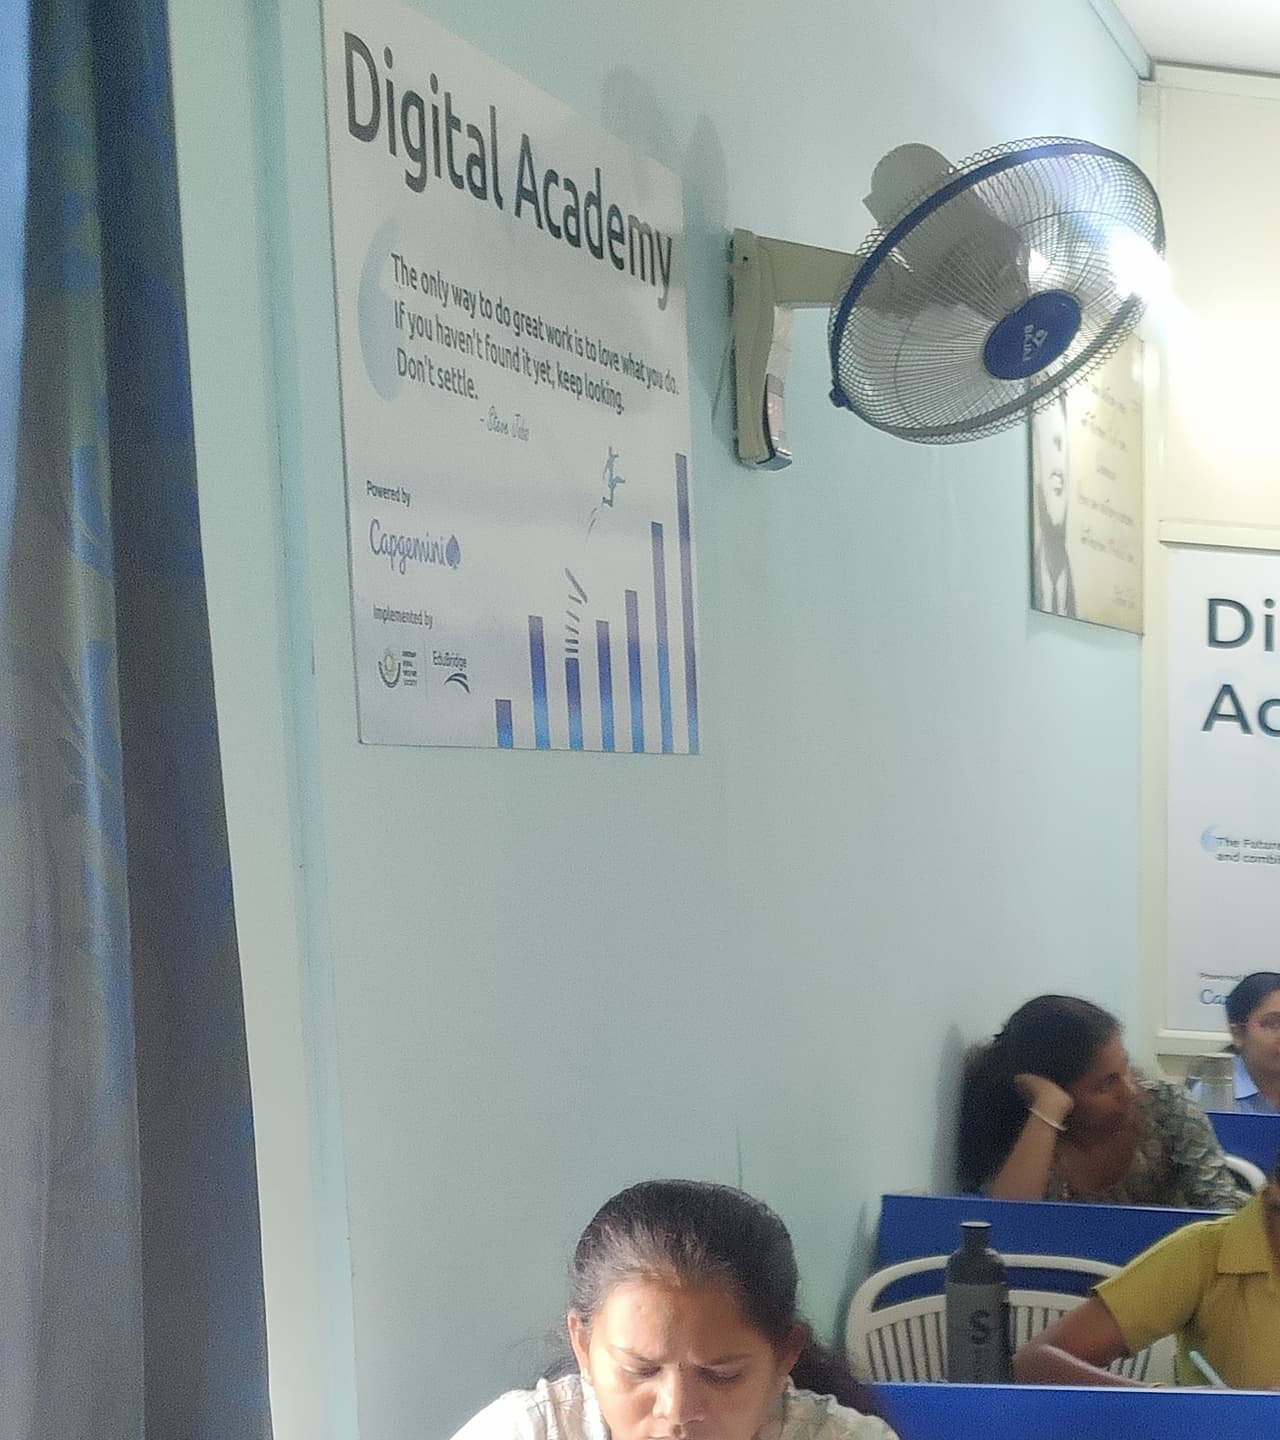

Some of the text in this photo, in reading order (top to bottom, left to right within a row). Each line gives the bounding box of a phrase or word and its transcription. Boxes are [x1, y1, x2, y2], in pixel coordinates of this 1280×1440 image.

[344, 31, 672, 310] Digital Academy
[391, 253, 679, 395] The only way to do great work is to love what you do.
[394, 300, 625, 415] If you haven't found it yet, keep looking.
[397, 348, 479, 400] Don't settle.
[367, 480, 411, 507] Powered by
[369, 518, 446, 575] Capgemini
[373, 604, 433, 630] Implemented by
[433, 650, 467, 671] EduBridge
[1215, 836, 1240, 848] The
[1217, 852, 1239, 862] and
